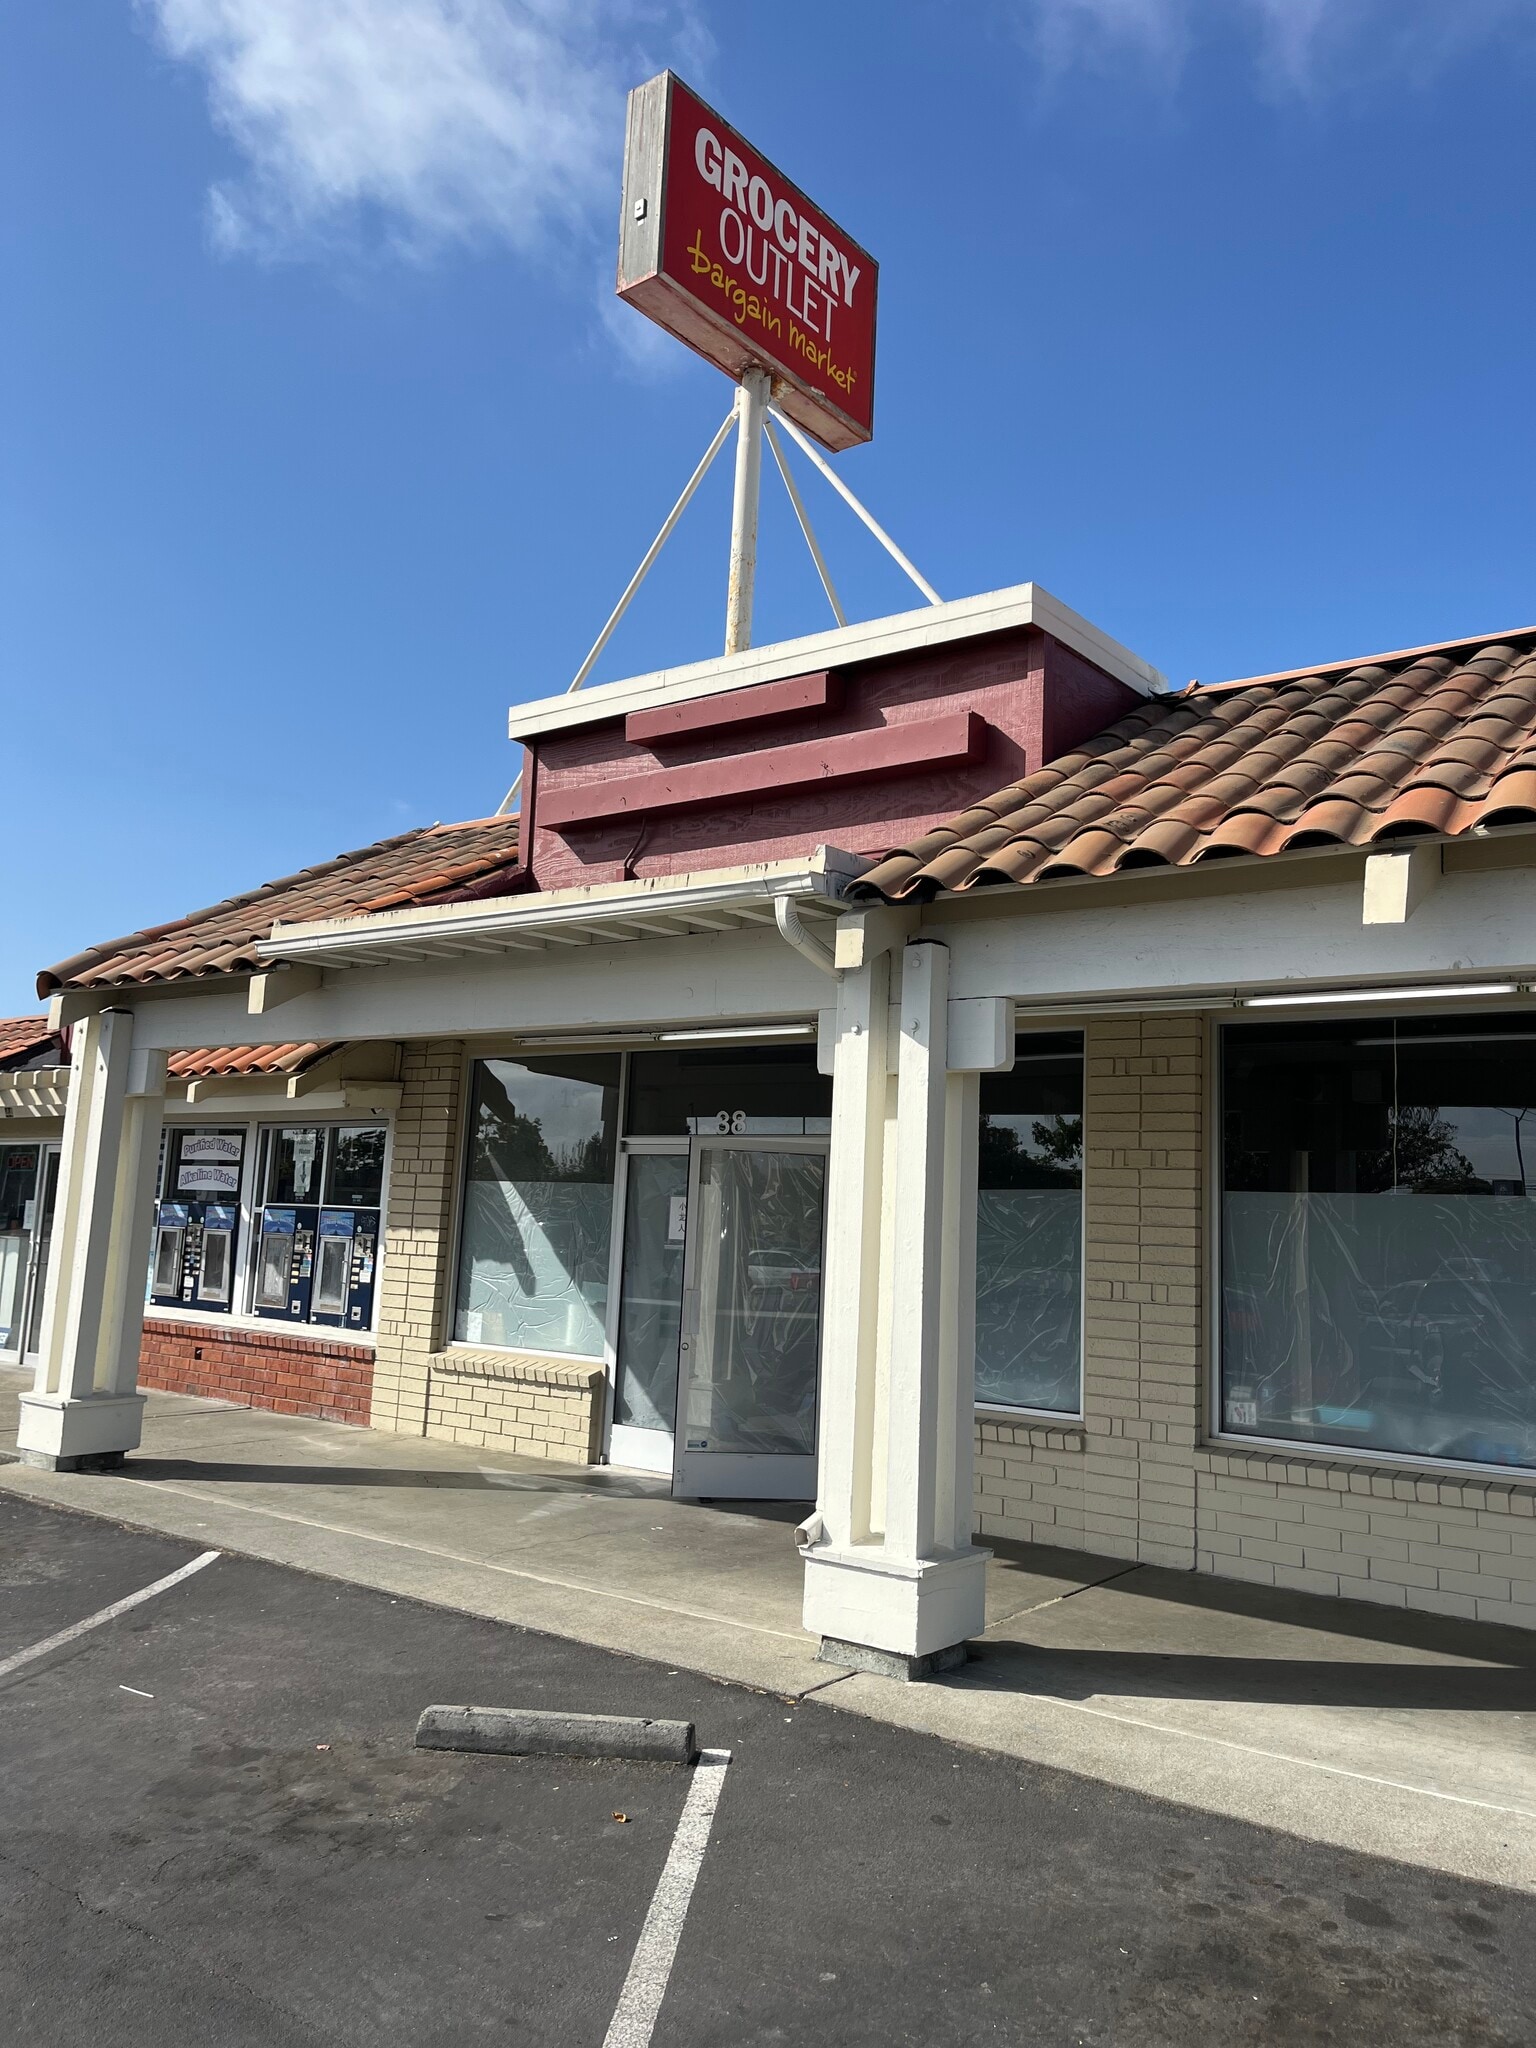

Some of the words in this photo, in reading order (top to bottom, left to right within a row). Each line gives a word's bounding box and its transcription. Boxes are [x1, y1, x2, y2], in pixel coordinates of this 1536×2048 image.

[695, 127, 860, 308] GROCERY
[687, 229, 781, 339] bargain
[789, 319, 856, 394] market
[720, 207, 838, 342] OUTLET
[7, 1155, 33, 1169] OPEN
[180, 1168, 213, 1187] Alkaline
[213, 1168, 238, 1188] Water
[183, 1137, 216, 1156] Purified
[215, 1137, 240, 1157] Water
